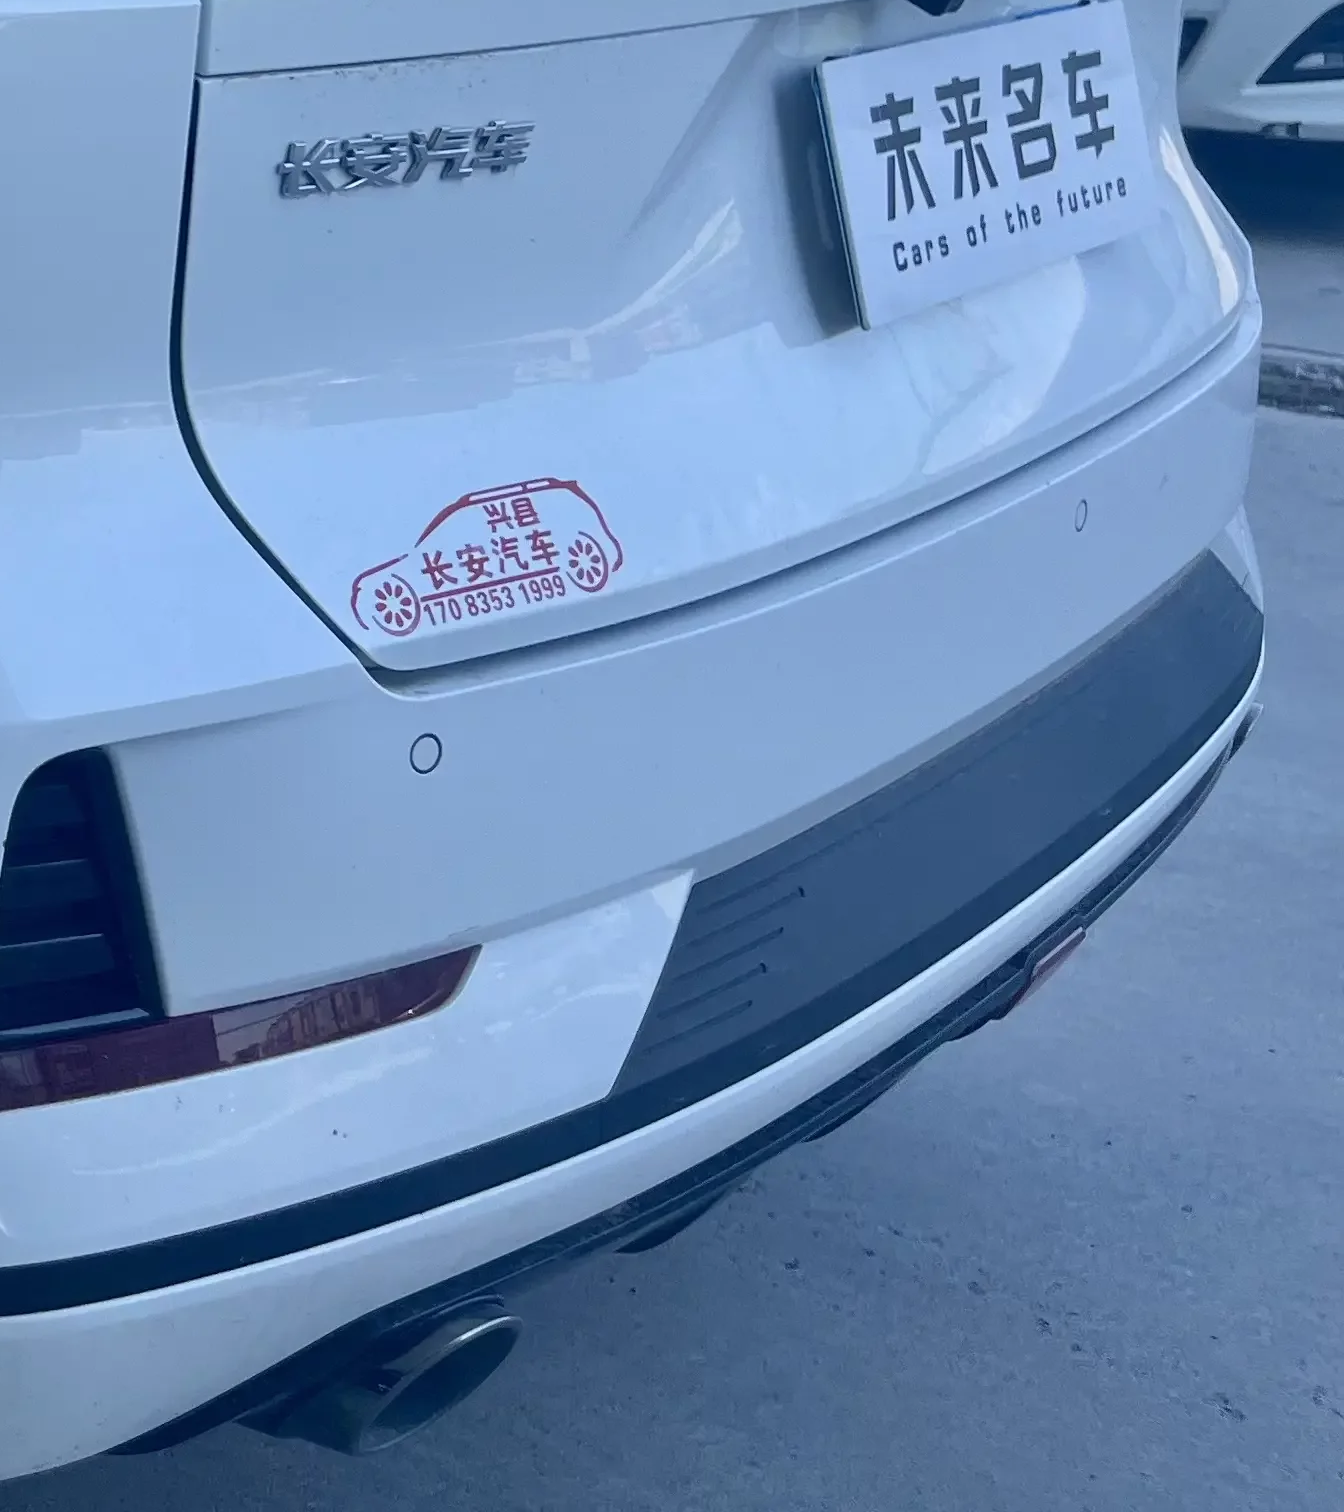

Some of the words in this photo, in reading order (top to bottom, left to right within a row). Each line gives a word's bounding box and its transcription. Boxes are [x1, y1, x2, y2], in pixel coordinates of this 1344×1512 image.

[277, 120, 536, 198] 长安汽车
[870, 49, 1115, 222] 未来名车
[892, 233, 949, 271] Cars
[966, 214, 987, 247] of
[1005, 202, 1042, 234] the
[1056, 176, 1127, 218] future
[421, 529, 559, 590] 长安汽车
[423, 598, 462, 626] 170
[465, 586, 515, 617] 8353
[518, 574, 566, 604] 1999
